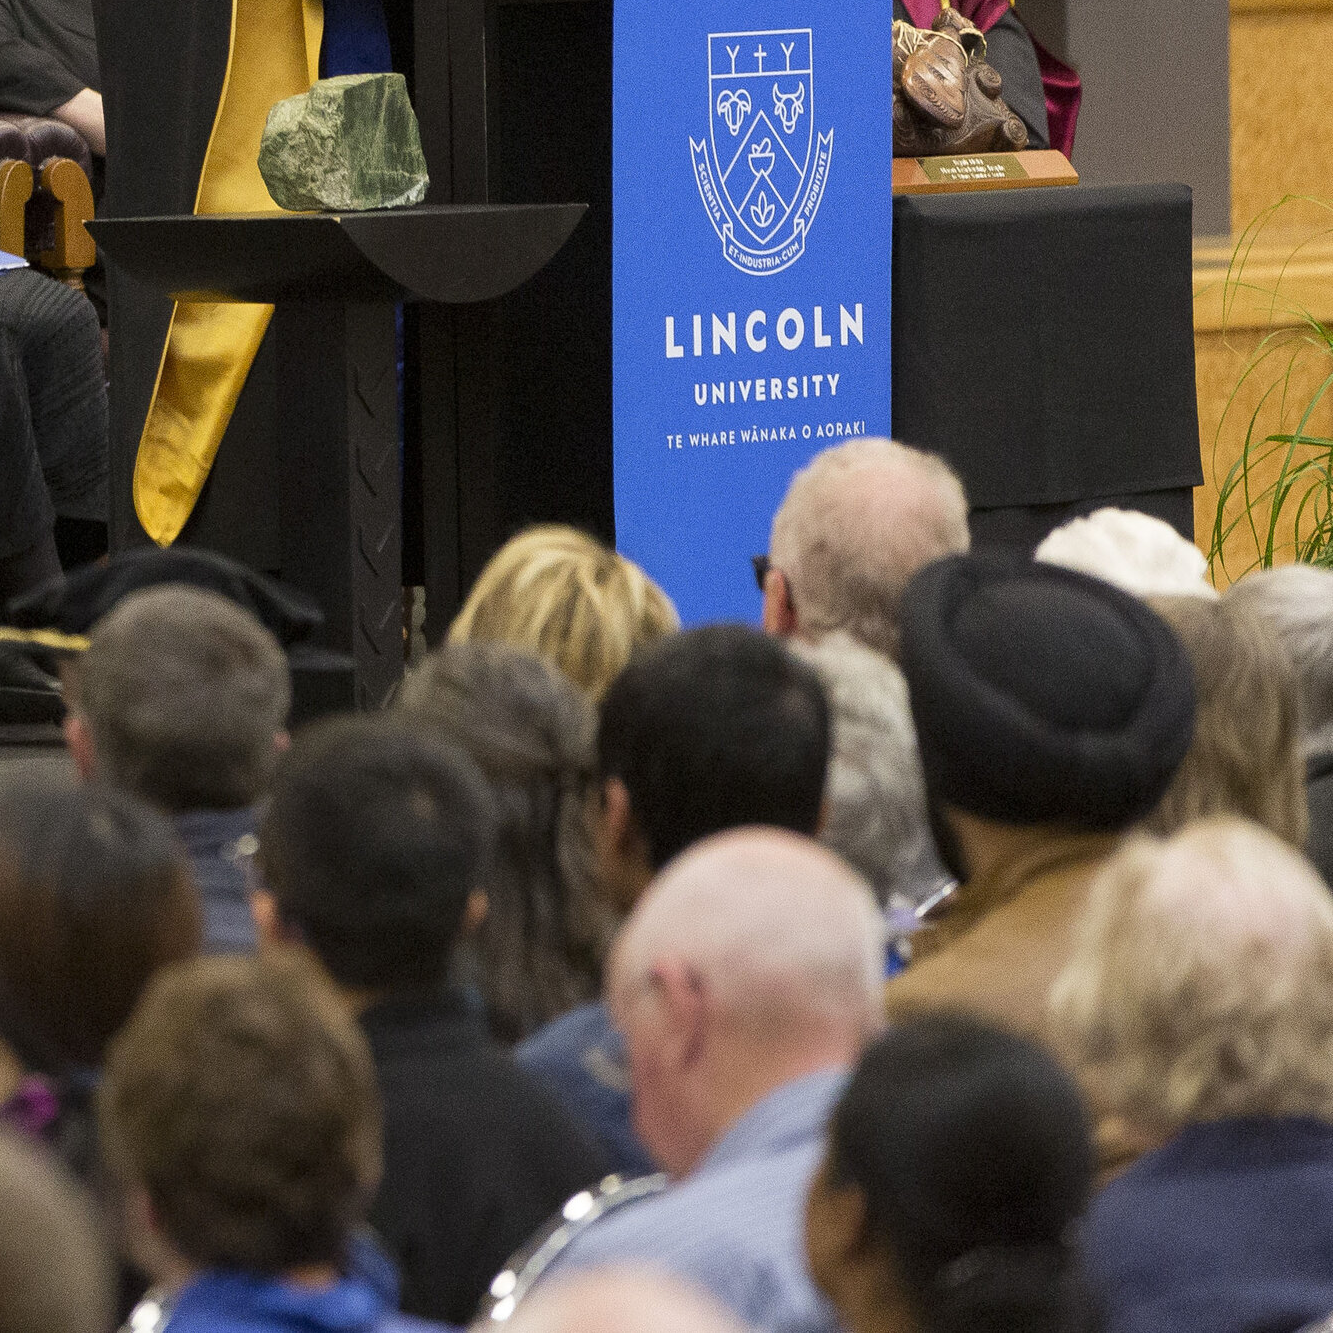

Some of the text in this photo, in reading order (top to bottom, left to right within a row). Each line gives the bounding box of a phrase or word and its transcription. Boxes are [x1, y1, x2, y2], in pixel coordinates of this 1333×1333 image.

[698, 163, 721, 221] SCIENTIA
[803, 151, 828, 217] PROBITATE
[665, 303, 863, 358] LINCOLN
[694, 373, 840, 406] UNIVERSITY
[667, 421, 865, 449] TE WHARE WĀNAKA O AORAKI
